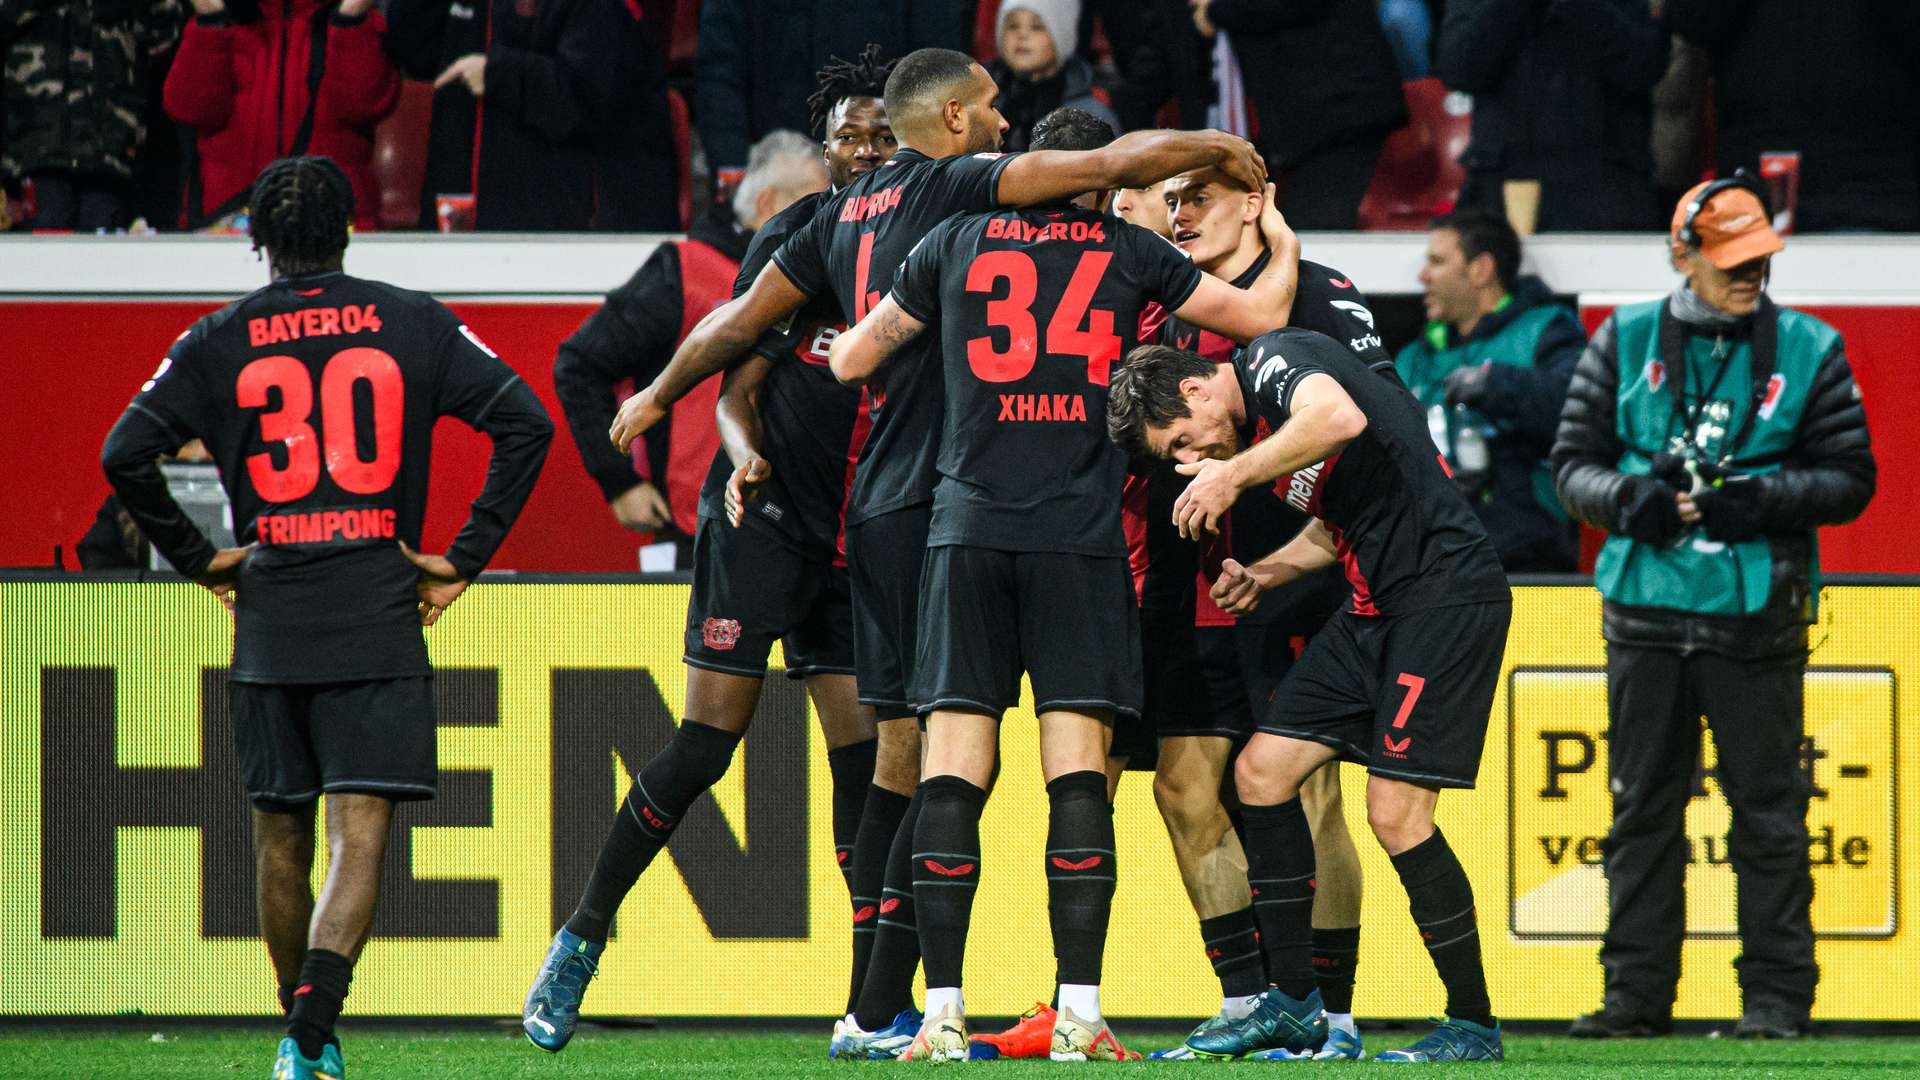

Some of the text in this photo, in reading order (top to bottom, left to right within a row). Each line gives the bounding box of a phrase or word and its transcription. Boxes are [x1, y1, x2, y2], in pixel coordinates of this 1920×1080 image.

[966, 250, 1122, 387] 34
[236, 346, 404, 504] 30
[997, 393, 1087, 421] XHAKA
[257, 508, 396, 544] FRIMPONG
[1392, 672, 1425, 729] 7
